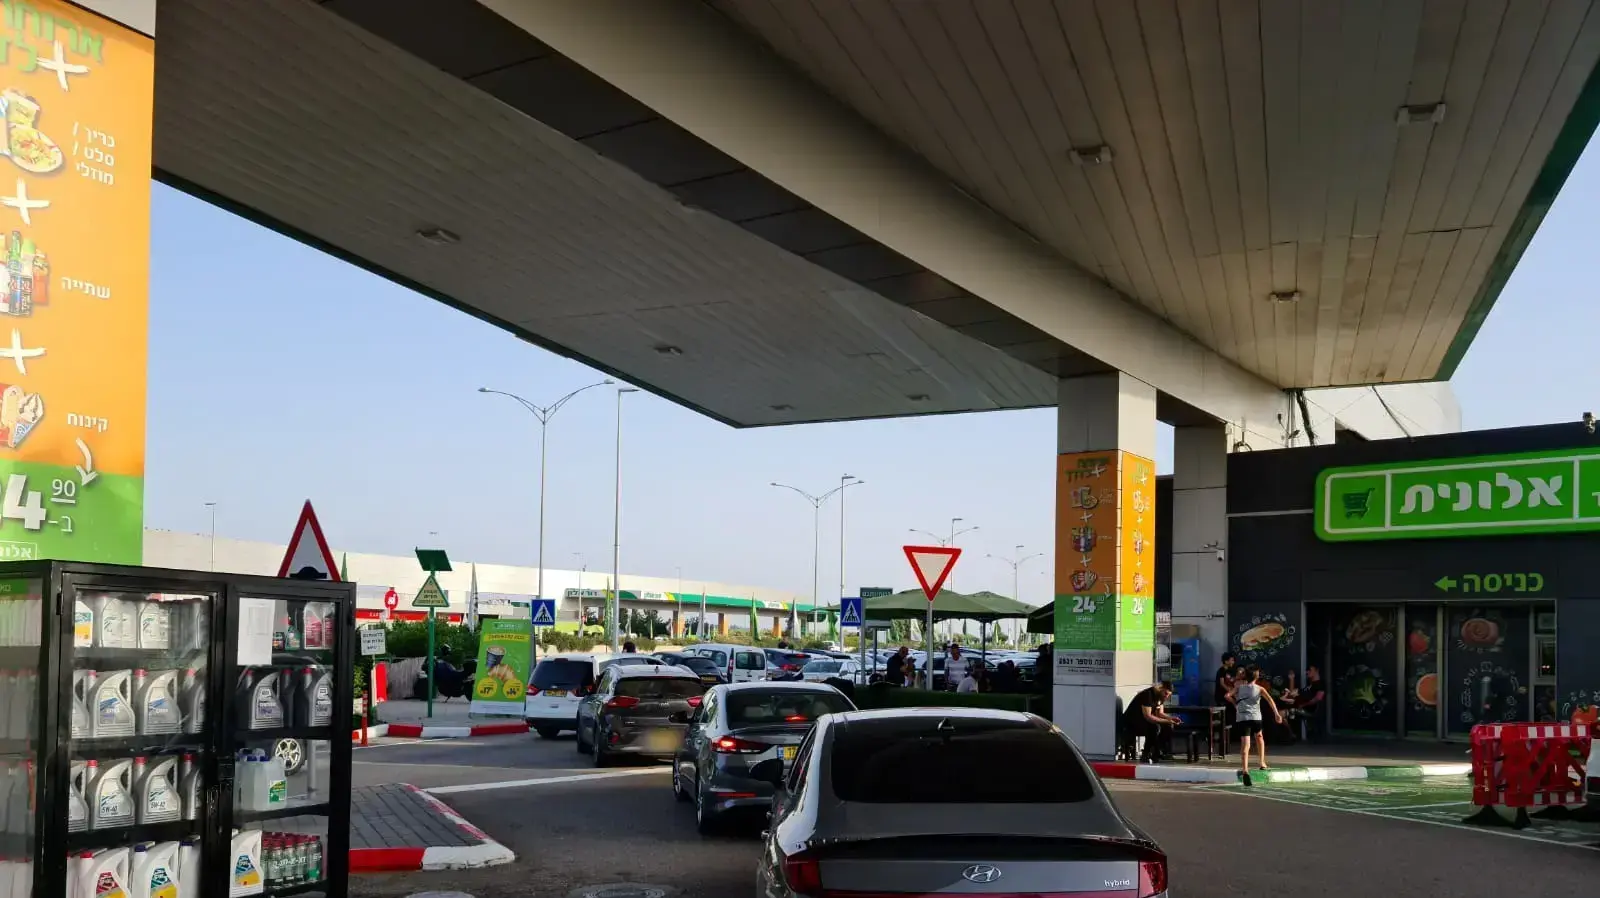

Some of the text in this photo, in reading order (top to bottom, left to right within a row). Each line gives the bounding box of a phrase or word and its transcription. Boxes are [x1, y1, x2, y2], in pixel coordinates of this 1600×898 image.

[83, 126, 115, 148] כריך
[84, 147, 115, 167] סלט
[75, 161, 114, 185] מוזלי
[61, 276, 111, 299] שתייה
[67, 412, 109, 432] קינוח
[52, 478, 76, 497] 90
[1400, 472, 1563, 514] אלונית
[1463, 573, 1544, 593] כניסה
[1072, 596, 1096, 613] 24
[1104, 879, 1130, 888] hybrid
